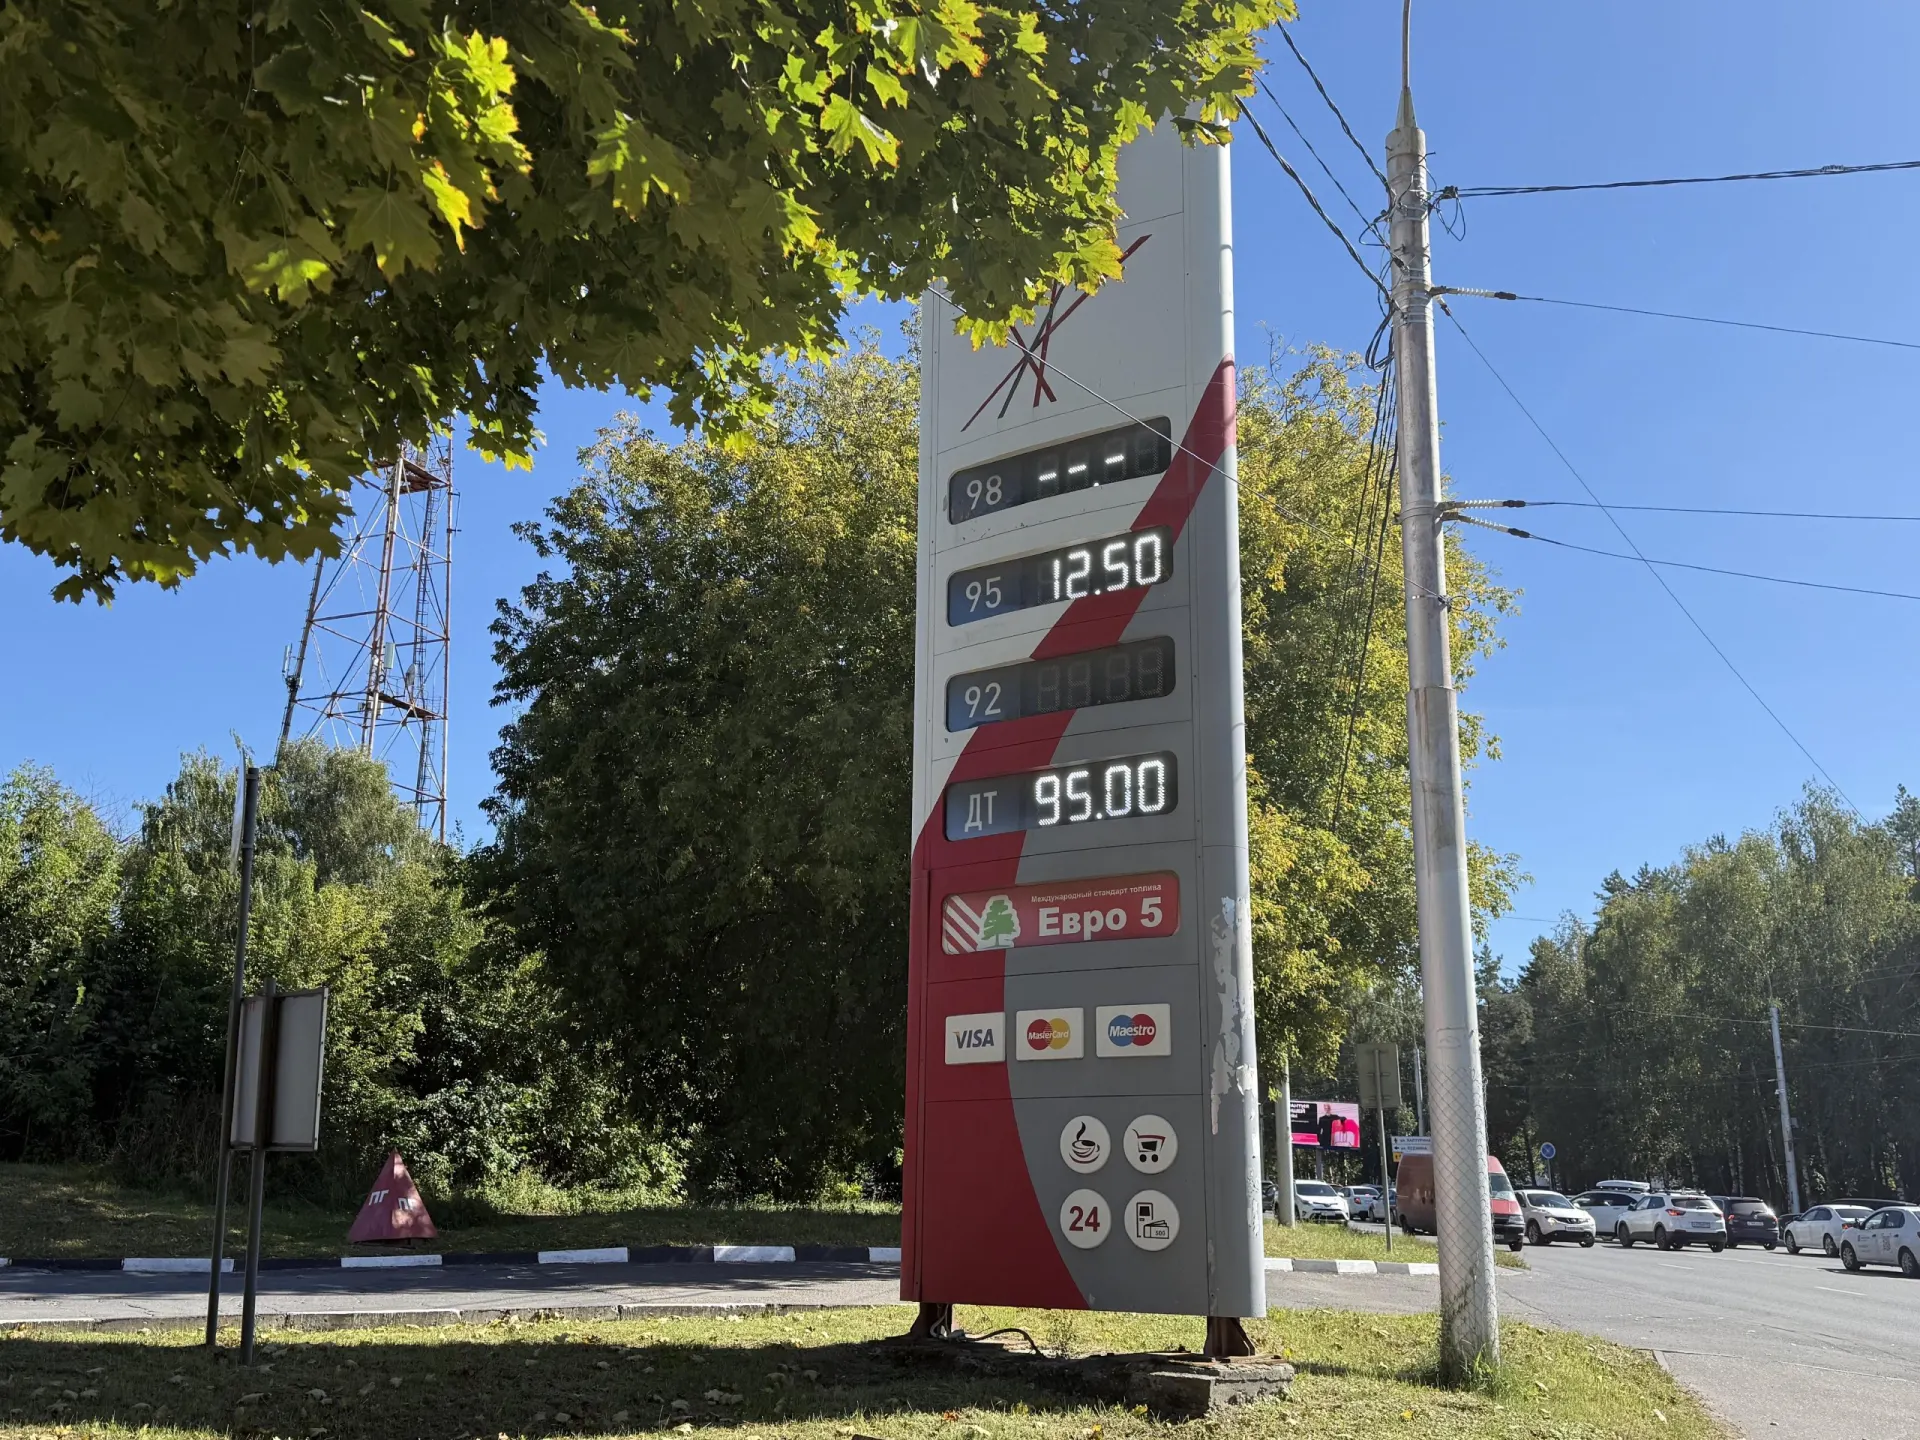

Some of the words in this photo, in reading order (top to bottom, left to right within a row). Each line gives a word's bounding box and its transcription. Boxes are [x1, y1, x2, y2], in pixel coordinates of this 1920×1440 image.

[966, 475, 1002, 510] 98
[965, 576, 1001, 613] 95
[1053, 534, 1162, 600] 12.50
[964, 682, 1001, 718] 92
[964, 791, 998, 832] ДТ
[1034, 759, 1165, 826] 95.00
[1031, 890, 1092, 903] Международный
[1093, 887, 1128, 897] стандарт
[1129, 884, 1162, 894] топлива
[1038, 906, 1127, 941] Евро
[1140, 896, 1163, 928] 5
[952, 1028, 995, 1049] VISA
[1028, 1029, 1069, 1041] MasterCard
[1109, 1025, 1155, 1037] Maestro
[368, 1189, 389, 1206] ПГ
[1068, 1205, 1100, 1232] 24
